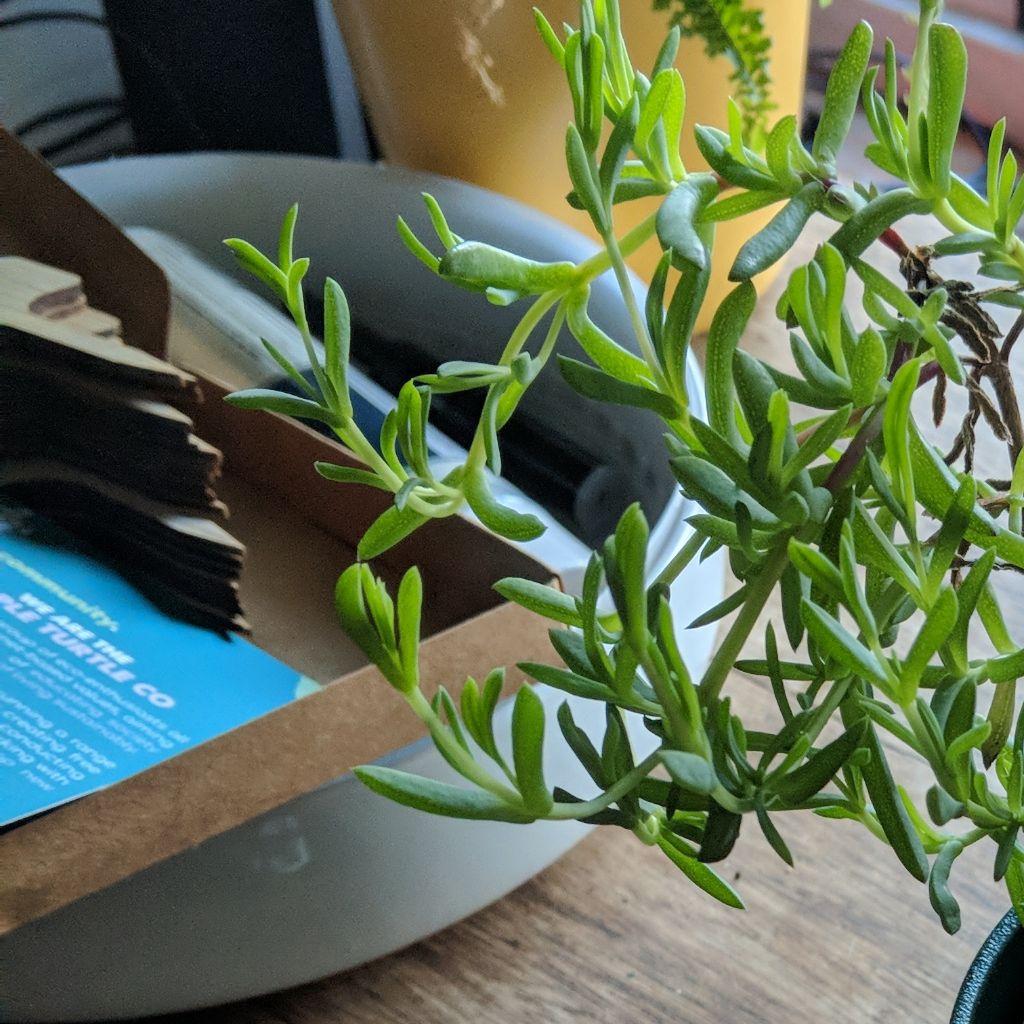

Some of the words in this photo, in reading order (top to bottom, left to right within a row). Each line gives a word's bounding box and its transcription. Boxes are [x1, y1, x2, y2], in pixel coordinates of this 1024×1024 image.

[19, 592, 55, 614] WE
[49, 614, 96, 640] ARE
[92, 638, 135, 665] THE
[38, 622, 136, 682] TURTLE
[133, 682, 176, 709] CO
[69, 738, 117, 768] range
